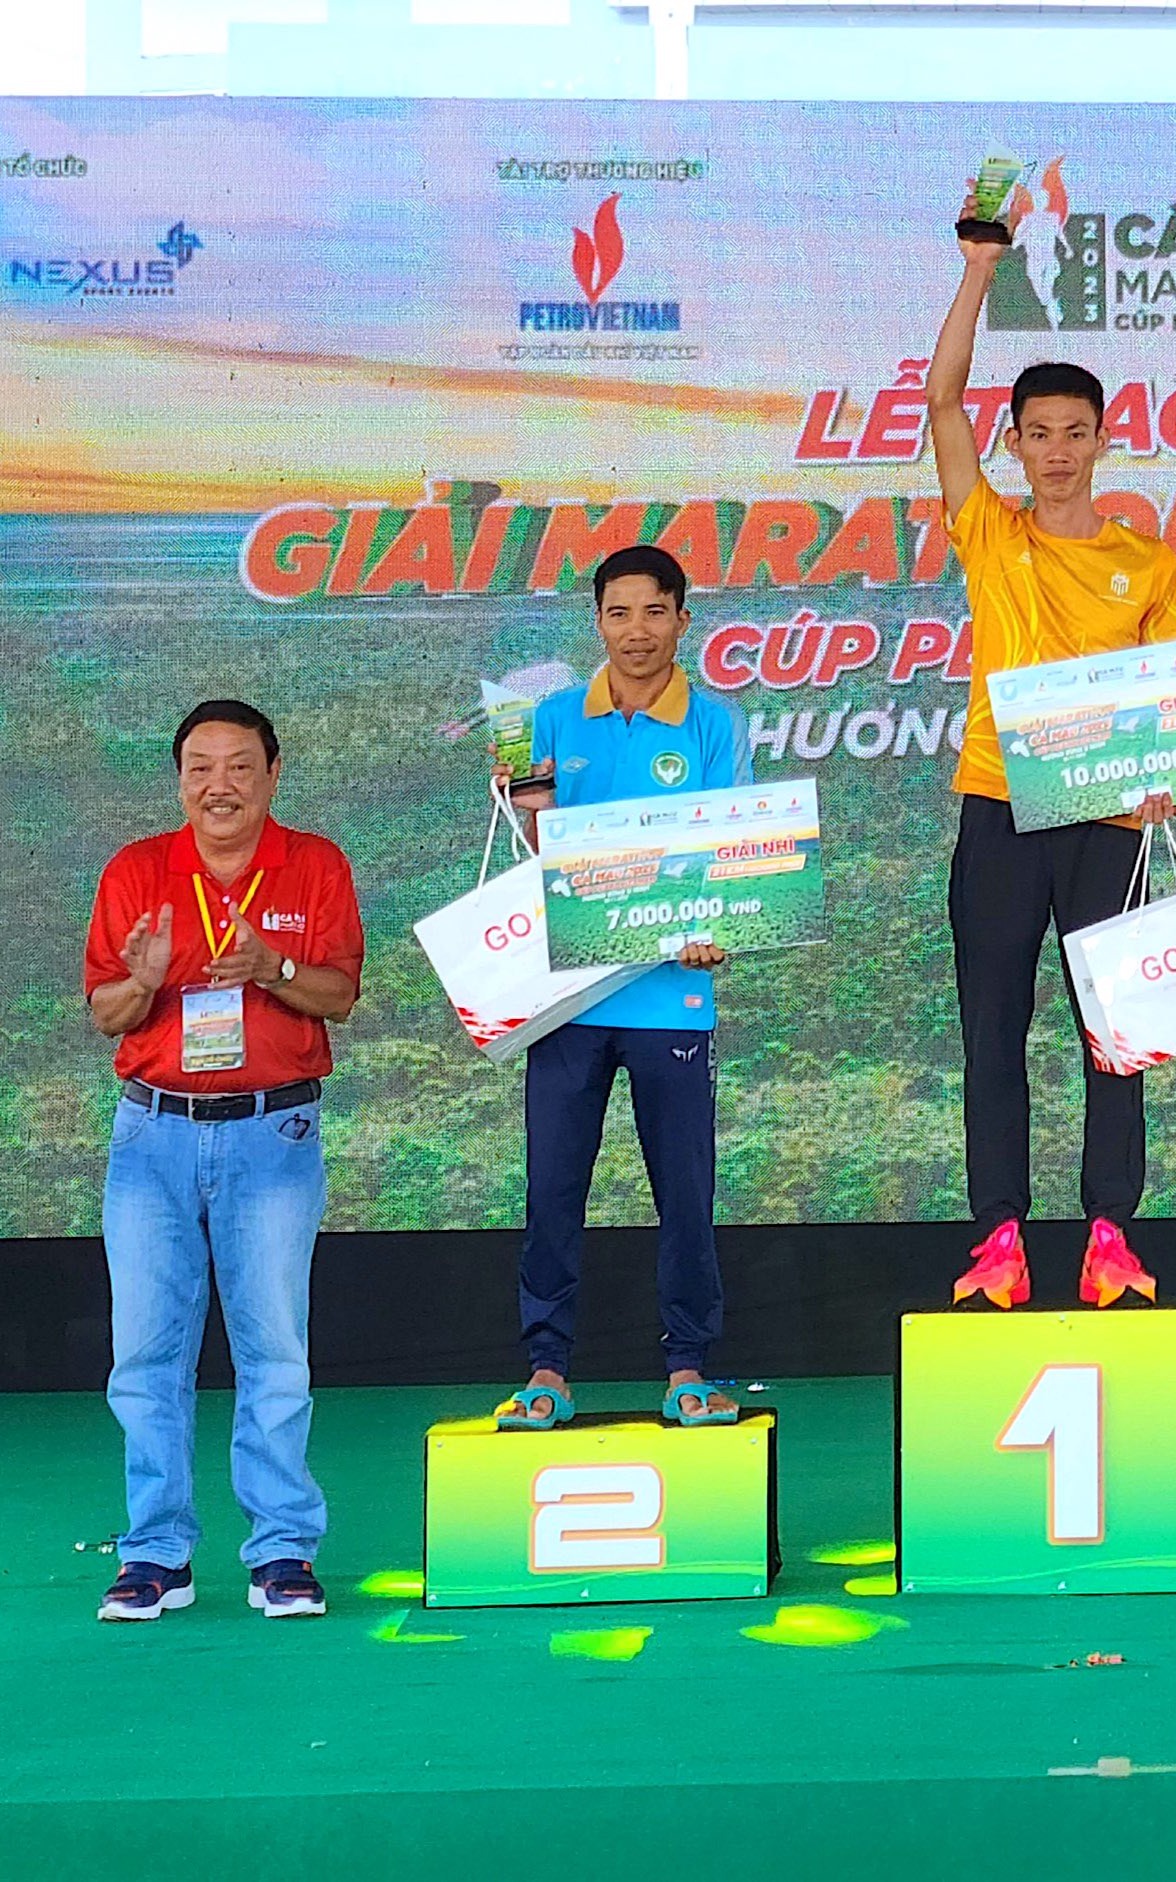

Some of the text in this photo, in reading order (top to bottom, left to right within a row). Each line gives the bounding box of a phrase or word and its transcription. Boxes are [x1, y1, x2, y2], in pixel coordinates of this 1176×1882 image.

[11, 260, 174, 293] NEXUS
[520, 303, 680, 331] PETROVIETNAM
[1114, 311, 1164, 332] CÚP
[241, 478, 520, 604] GIẢI
[701, 608, 880, 690] CÚP
[716, 839, 757, 861] GIẢI
[606, 897, 723, 931] 7.000.000
[996, 1363, 1102, 1543] 1
[531, 1463, 664, 1573] 2
